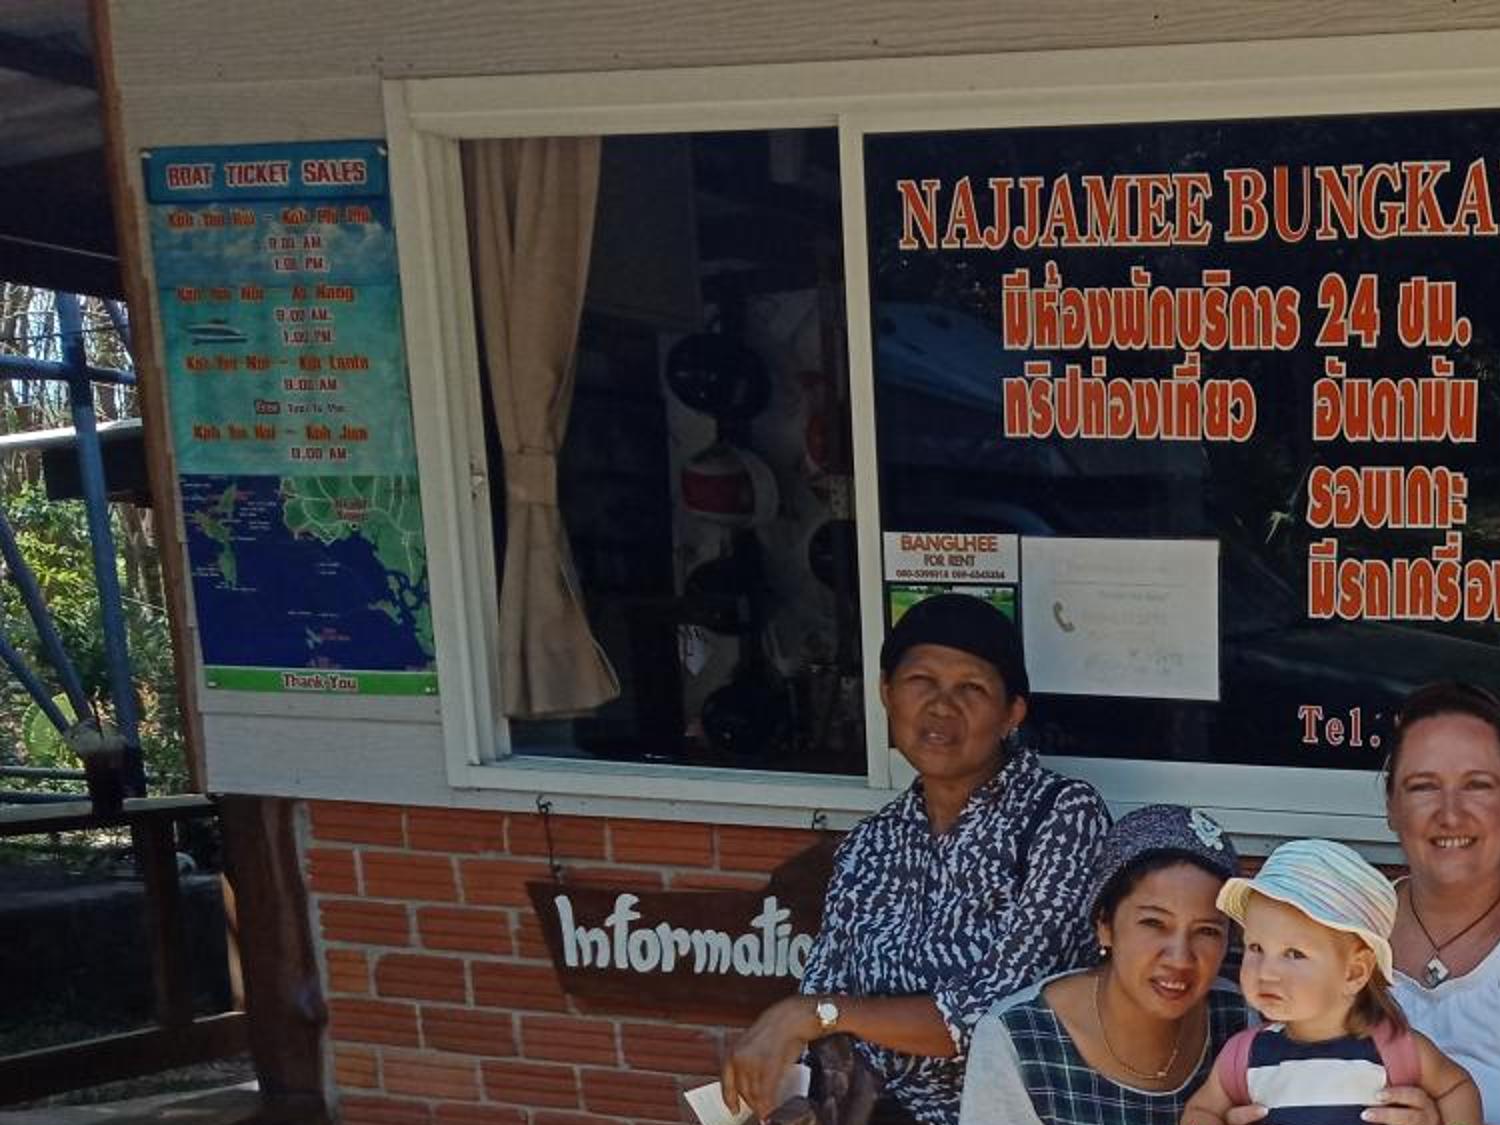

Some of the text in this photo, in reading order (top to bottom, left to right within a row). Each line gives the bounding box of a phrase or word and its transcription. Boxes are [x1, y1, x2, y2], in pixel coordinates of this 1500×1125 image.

[168, 159, 367, 190] BOAT TICKET SALES
[897, 171, 1213, 250] NAJJAMEE
[1002, 260, 1472, 350] มีห้องพักบริการ 24 ชม.
[1003, 352, 1479, 443] ทริปท่องเที่ยว อันดามัน
[1307, 466, 1469, 529] รอบเกาะ
[924, 554, 976, 567] FOR RENT
[283, 673, 358, 691] Thank You
[1298, 704, 1382, 748] Tel.
[554, 893, 816, 979] Informatio
